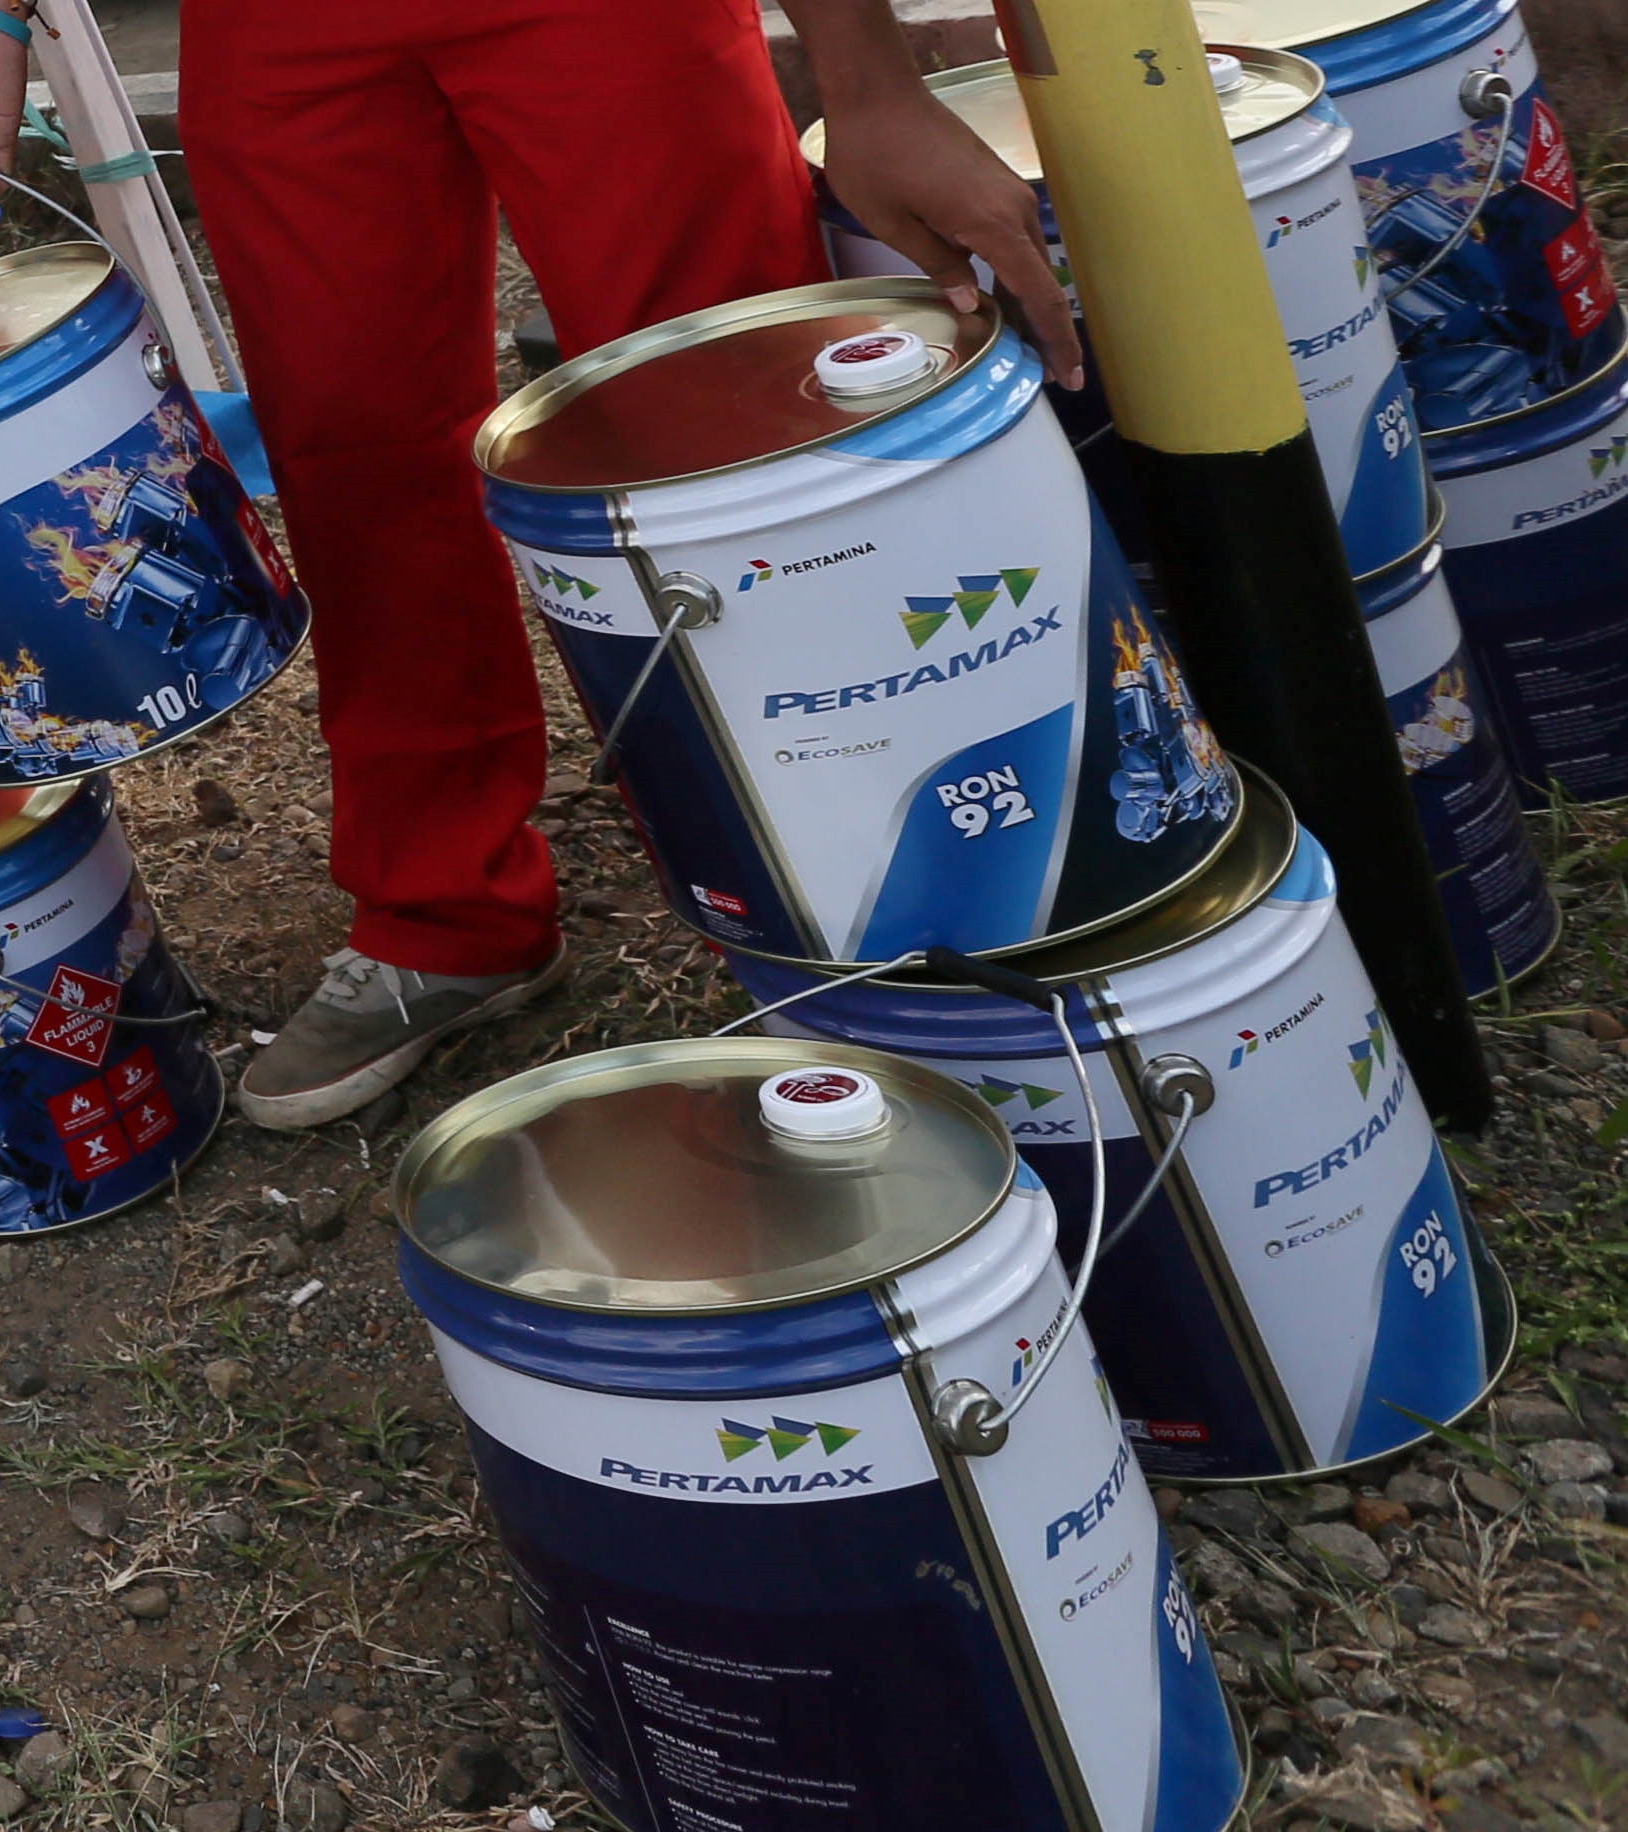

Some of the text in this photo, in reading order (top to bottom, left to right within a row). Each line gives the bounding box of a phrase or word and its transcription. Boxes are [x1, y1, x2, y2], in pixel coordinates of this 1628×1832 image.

[1297, 197, 1342, 230] PERTAMINA
[1305, 374, 1355, 403] COSAVE
[1375, 394, 1405, 434] RON
[1382, 421, 1413, 460] 92
[1511, 475, 1628, 530] PERTAM
[781, 541, 877, 577] PERTAMINA
[763, 605, 1063, 721] PERTAMAX
[941, 764, 1021, 810] RON
[949, 790, 1035, 840] 92
[24, 899, 74, 933] PERTAMINA
[66, 1019, 105, 1048] LIQUID
[1264, 991, 1325, 1043] PERTAMINA
[86, 1040, 97, 1053] 3
[1399, 1208, 1446, 1268] RON
[1411, 1234, 1459, 1299] 92
[600, 1458, 874, 1495] PERTAMAX
[1045, 1438, 1134, 1562] PERTA
